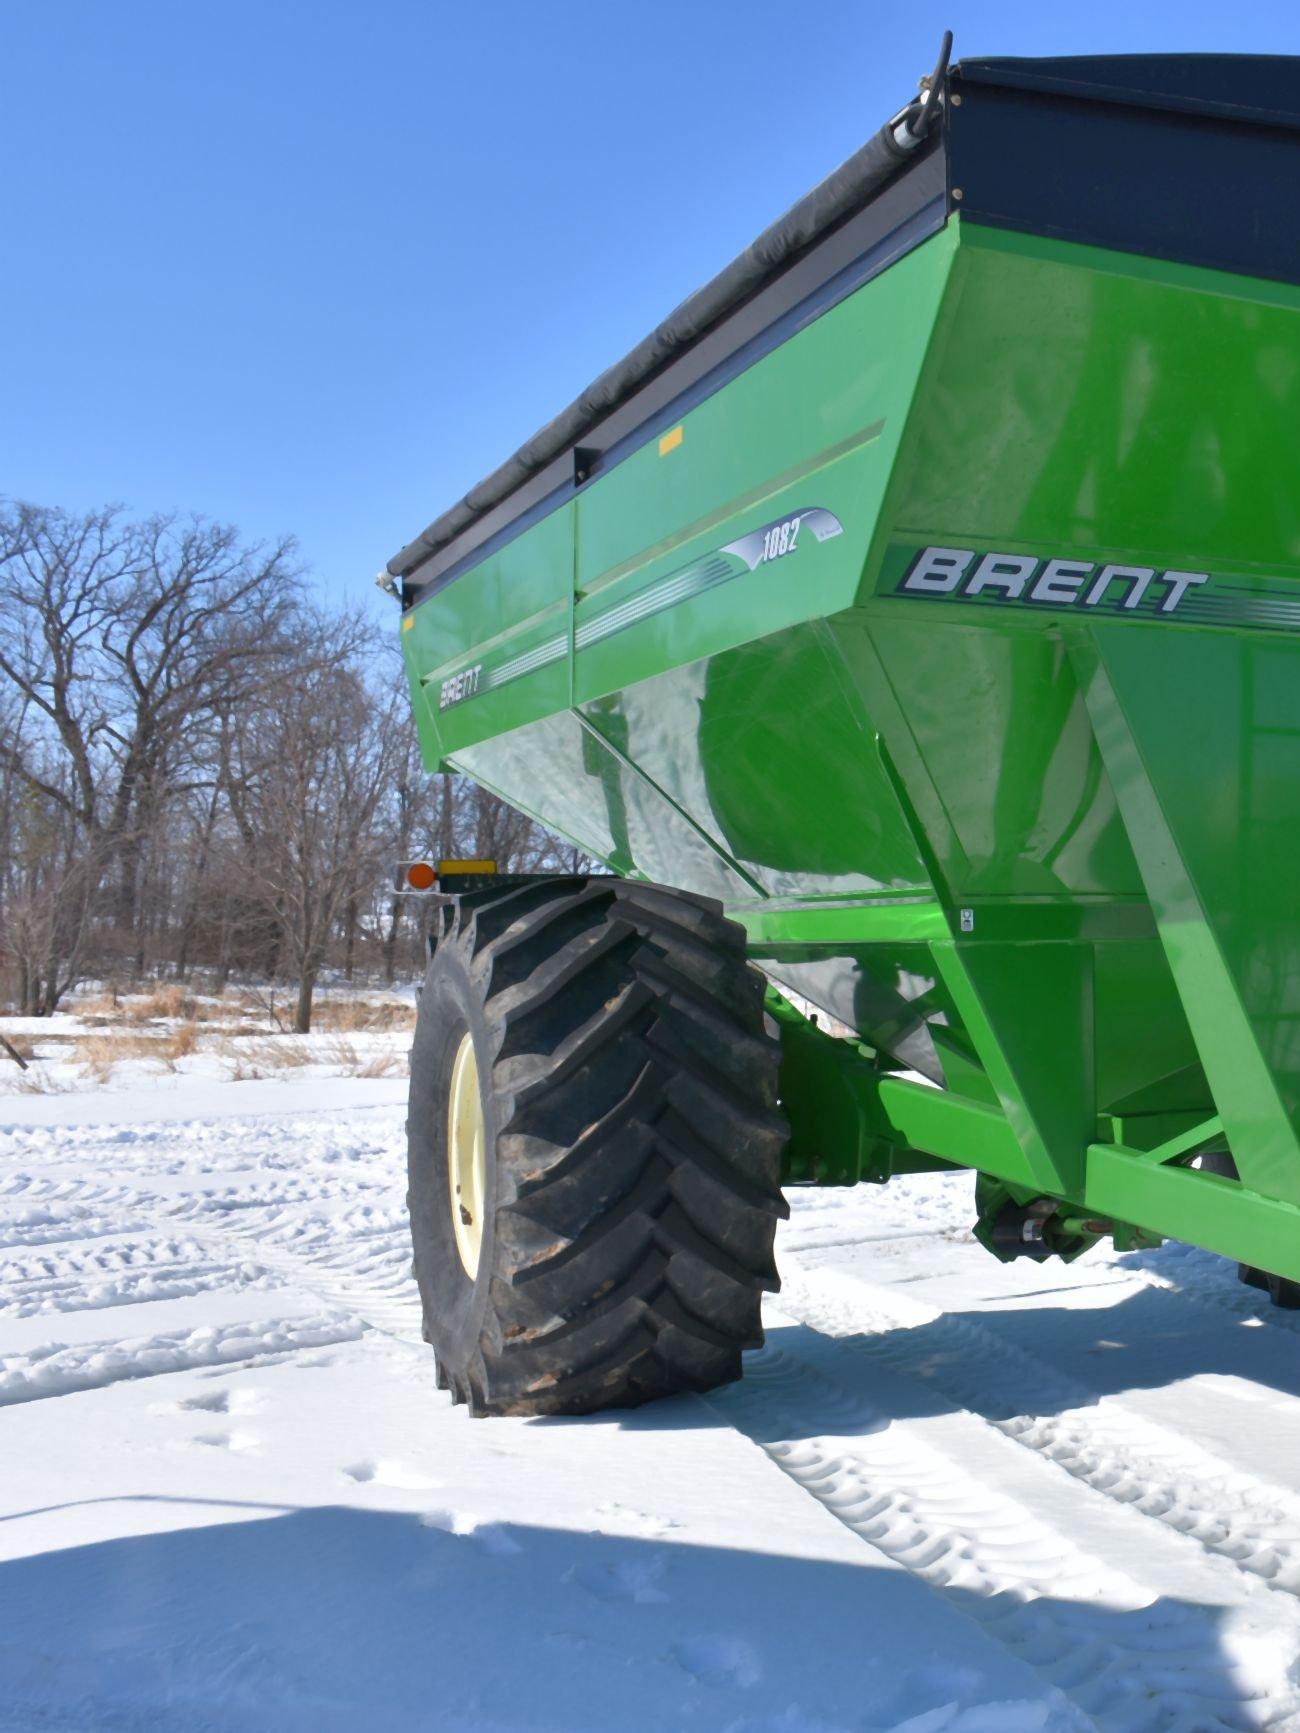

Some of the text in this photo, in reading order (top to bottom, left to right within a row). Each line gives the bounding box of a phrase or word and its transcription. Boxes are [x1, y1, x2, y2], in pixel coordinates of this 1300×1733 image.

[763, 517, 801, 562] 1082
[902, 546, 1209, 612] BRENT
[440, 664, 482, 709] BRENT
